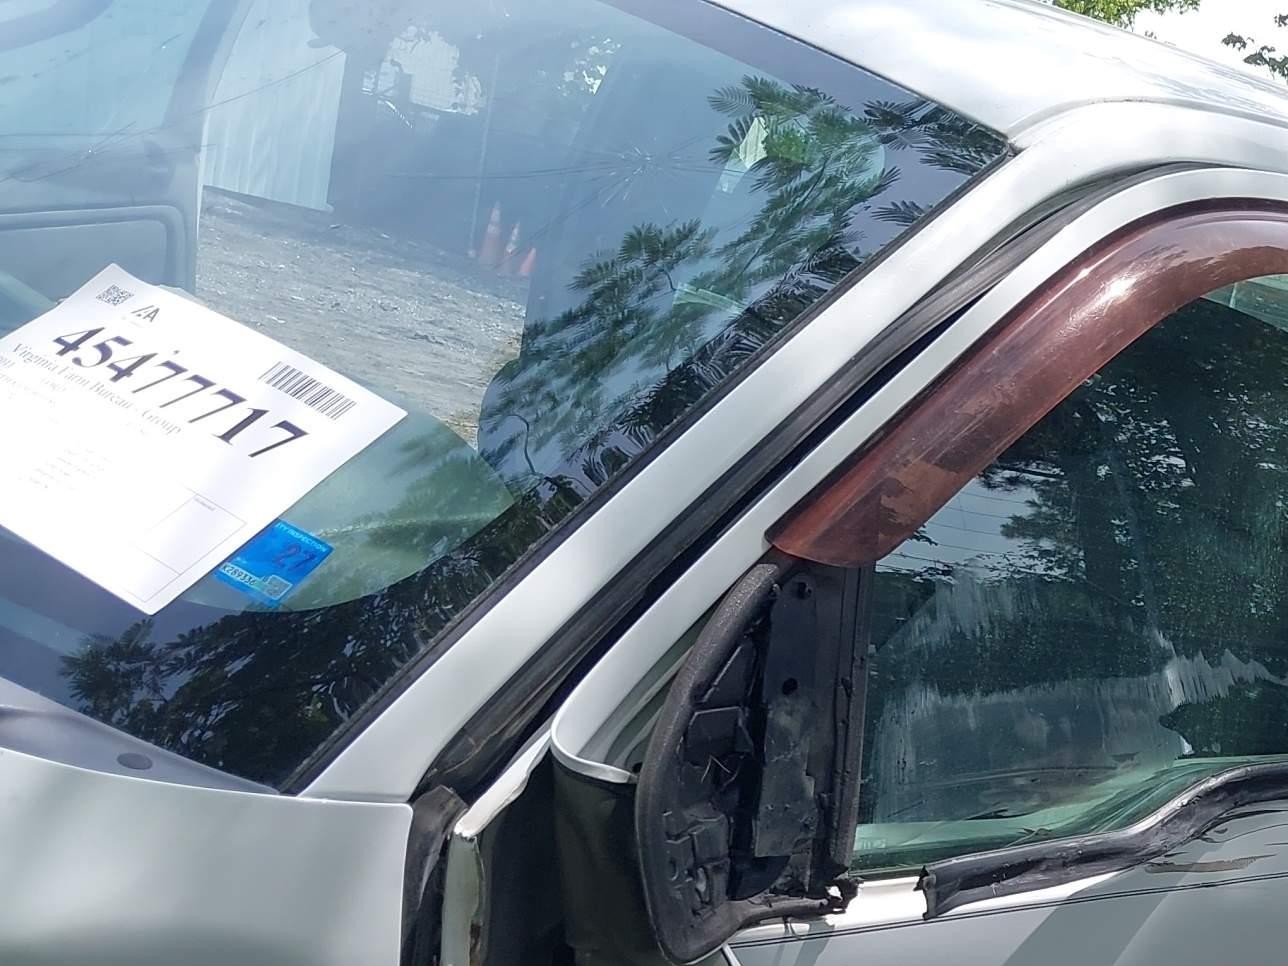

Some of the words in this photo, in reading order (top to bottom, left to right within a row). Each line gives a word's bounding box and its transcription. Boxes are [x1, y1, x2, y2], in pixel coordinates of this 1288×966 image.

[12, 342, 59, 373] Virginia
[141, 408, 183, 436] Group
[52, 327, 309, 458] 45477717
